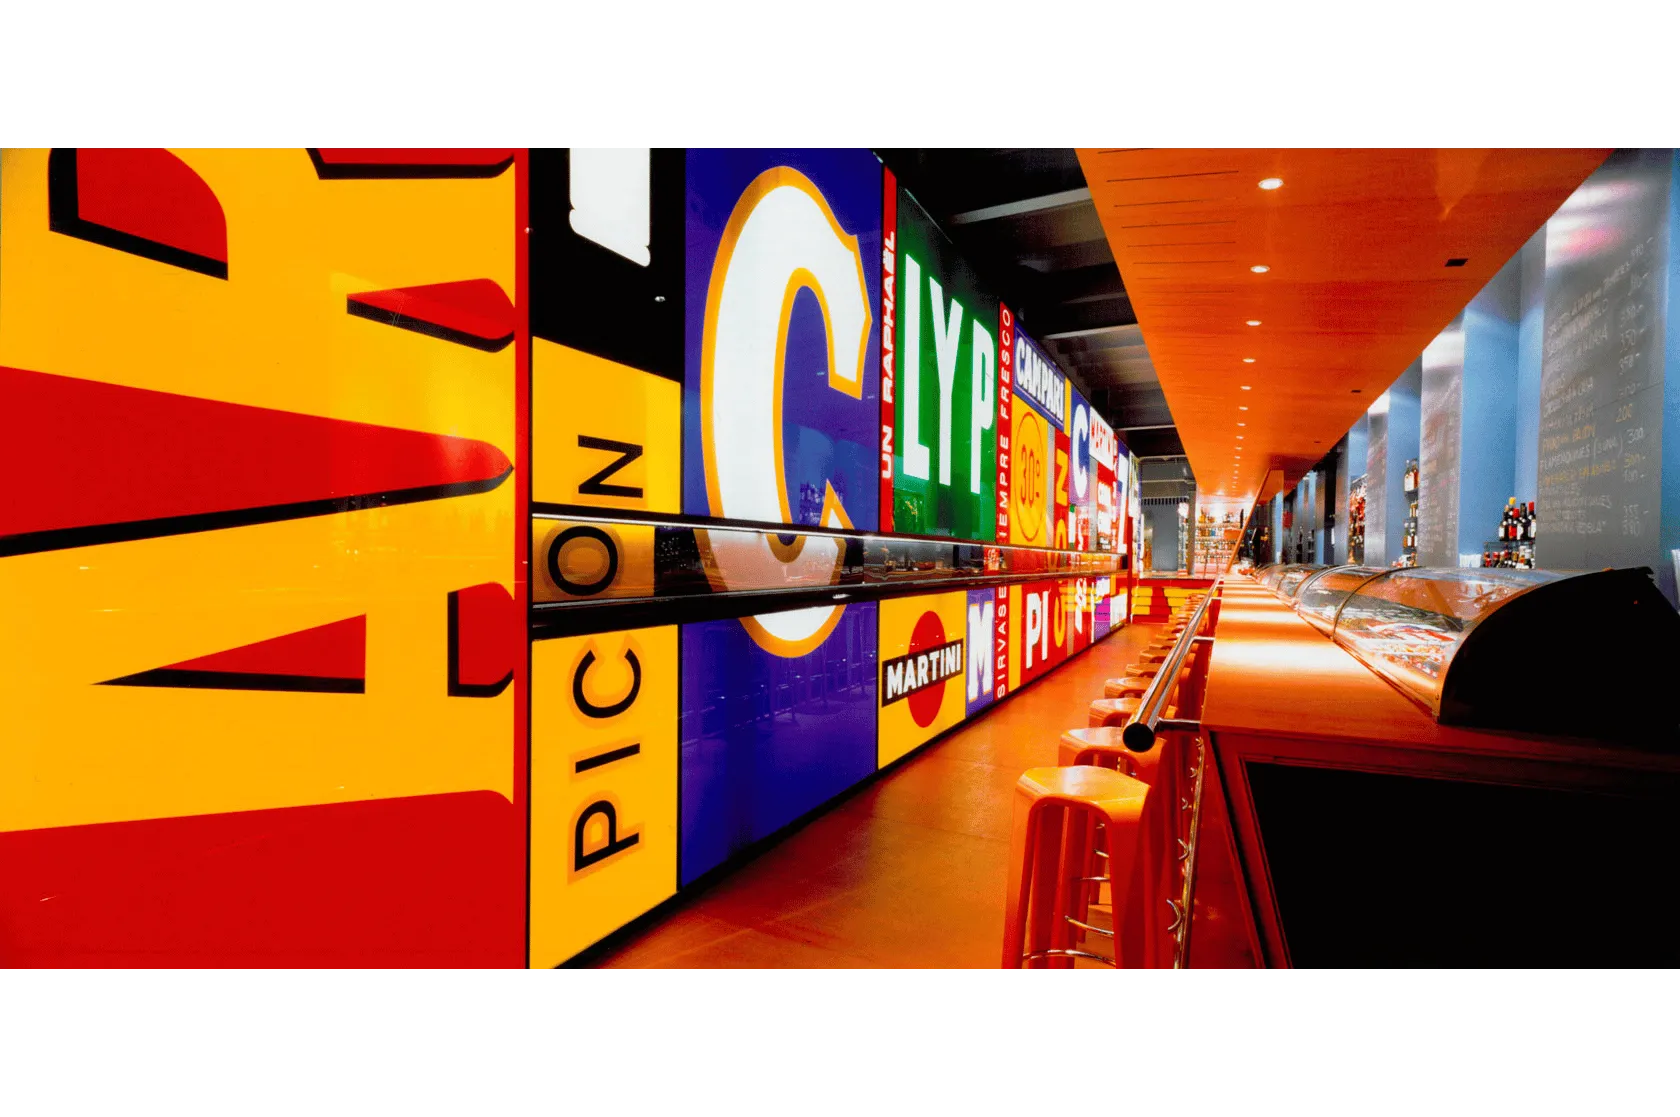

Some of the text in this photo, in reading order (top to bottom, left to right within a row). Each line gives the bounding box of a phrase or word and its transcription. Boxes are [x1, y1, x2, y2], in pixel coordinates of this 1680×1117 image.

[903, 253, 995, 495] LYP
[1000, 308, 1012, 426] FRESCO
[1015, 335, 1065, 424] CAMPARI
[881, 425, 894, 480] UN
[547, 434, 644, 873] PICON
[886, 642, 962, 700] MARTINI
[968, 601, 994, 703] M
